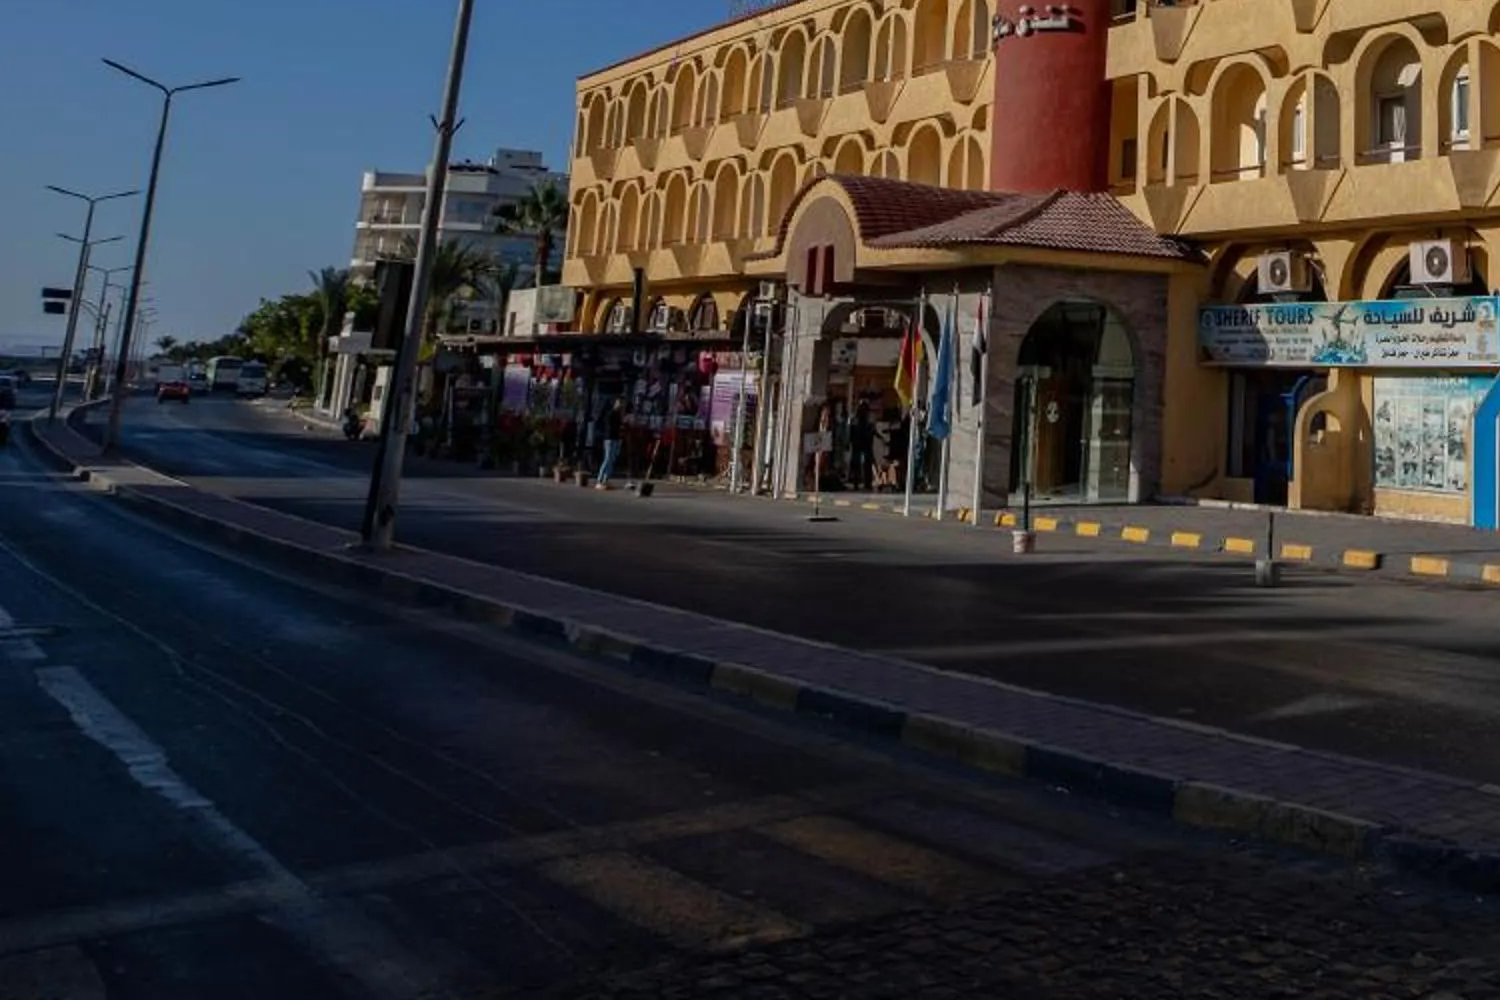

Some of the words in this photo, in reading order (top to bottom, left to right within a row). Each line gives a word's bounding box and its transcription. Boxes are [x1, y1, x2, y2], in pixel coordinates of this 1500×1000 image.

[1216, 308, 1261, 327] SHERIF
[1266, 307, 1314, 325] TOURS
[1364, 307, 1424, 329] للسياحة
[1429, 303, 1476, 328] شريف
